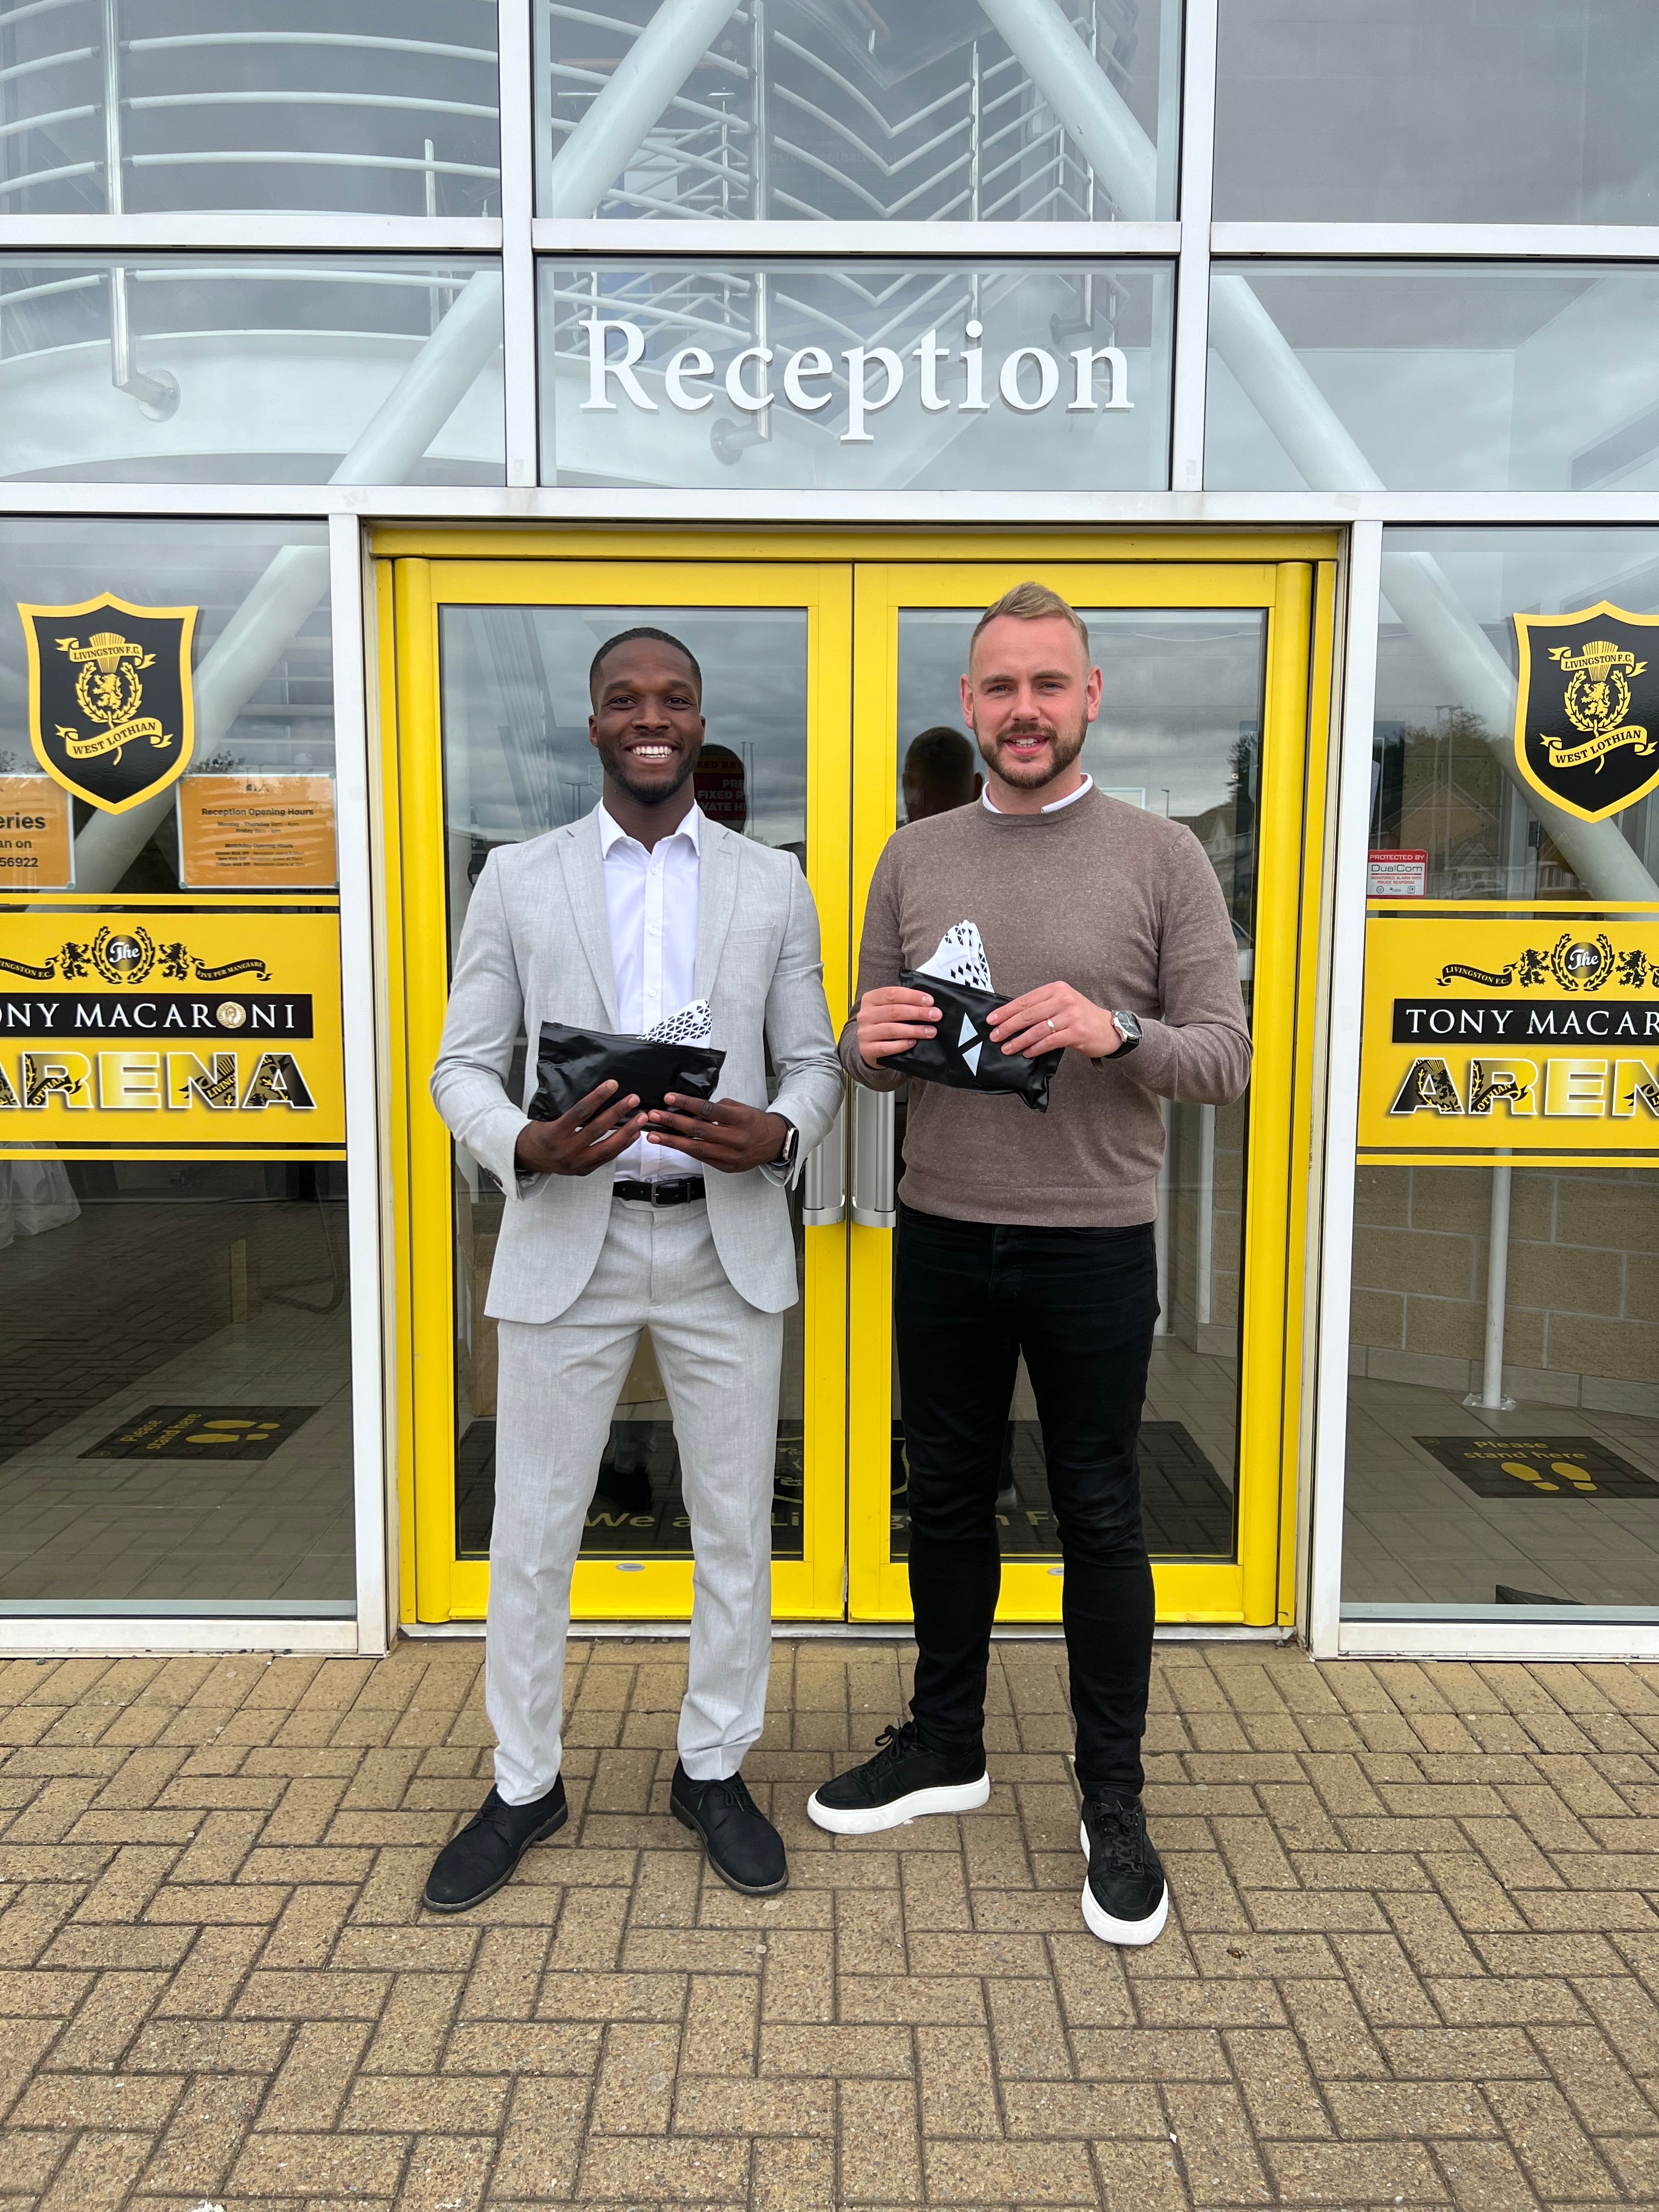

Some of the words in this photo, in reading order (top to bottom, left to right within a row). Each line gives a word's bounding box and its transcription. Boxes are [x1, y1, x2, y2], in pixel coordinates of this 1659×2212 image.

[579, 320, 1134, 441] Reception
[74, 647, 124, 659] LIVINGSTON
[1565, 654, 1616, 669] LIVINGSTON
[73, 741, 105, 754] WEST
[106, 723, 156, 746] LOTHIAN
[1556, 749, 1588, 764] WEST
[1590, 730, 1641, 754] LOTHIAN
[0, 857, 38, 867] 56922
[110, 942, 140, 963] The
[1567, 949, 1599, 970] The
[1446, 966, 1494, 983] LIVINGSTON
[0, 1003, 60, 1027] NY
[1406, 1009, 1514, 1034] TONY
[119, 1420, 162, 1442] Please
[146, 1430, 181, 1450] stand
[168, 1414, 202, 1429] here
[1464, 1451, 1528, 1459] stand
[1531, 1451, 1587, 1459] here
[1474, 1441, 1548, 1449] Please
[584, 1513, 656, 1527] We
